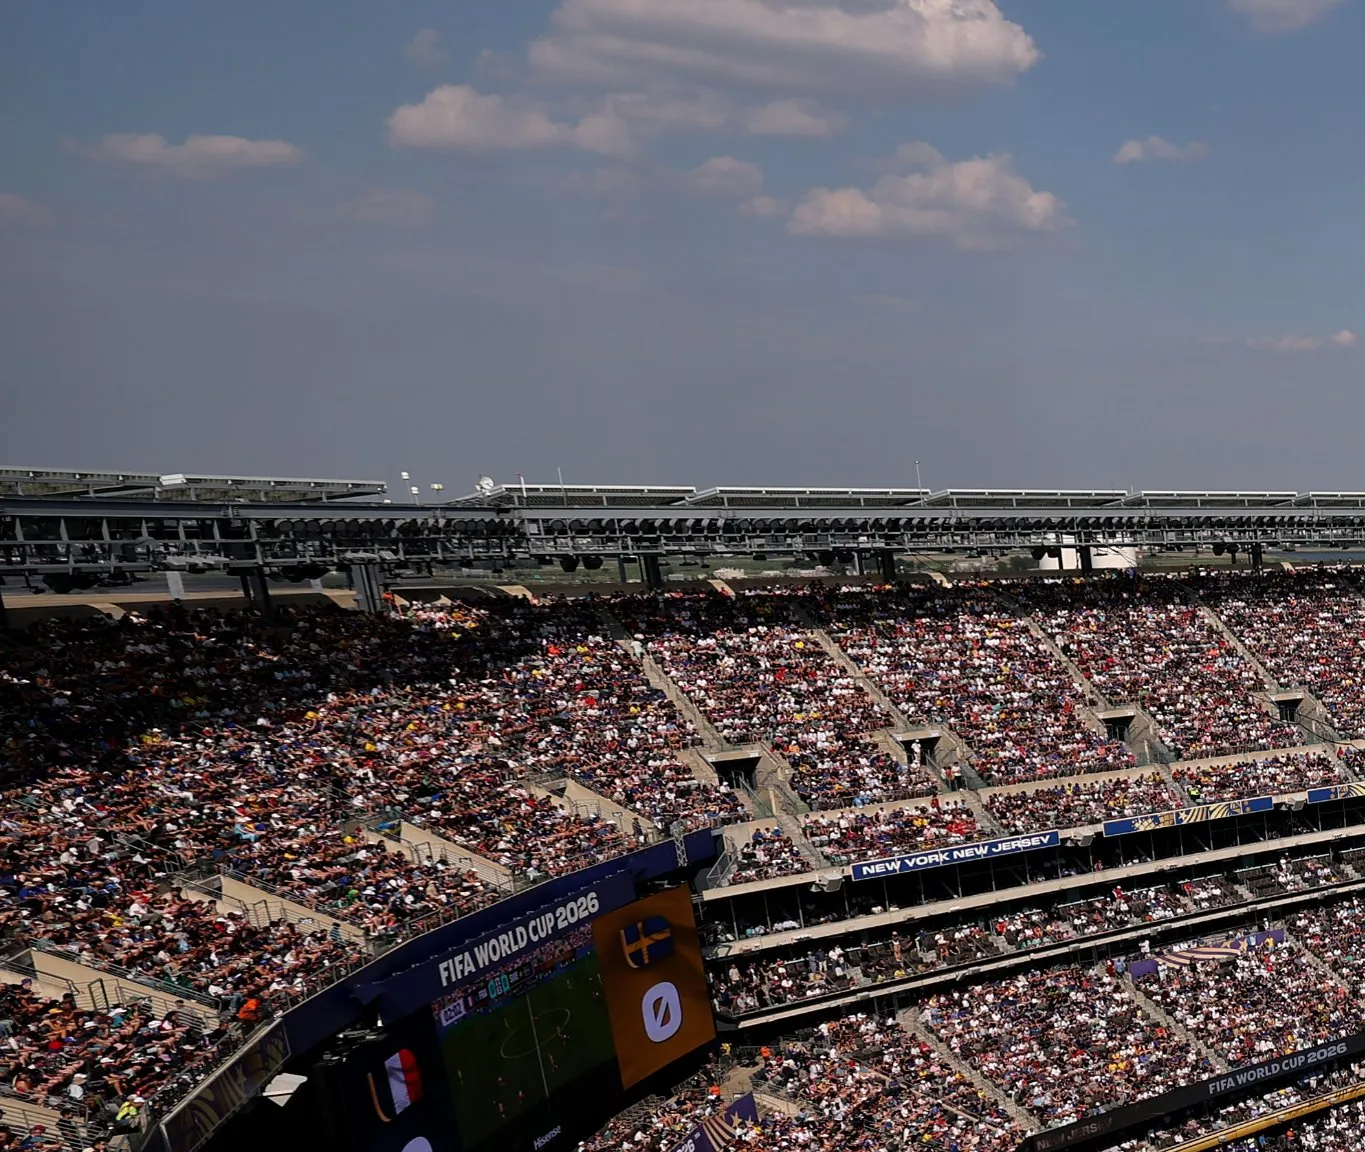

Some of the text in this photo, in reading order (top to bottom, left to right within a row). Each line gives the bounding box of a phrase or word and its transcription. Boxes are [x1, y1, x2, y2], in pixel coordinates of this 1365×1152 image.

[862, 835, 1050, 876] NEW YORK NEW JERSEY
[438, 954, 476, 987] FIFA
[473, 926, 527, 968] WORLD
[528, 912, 555, 942] CUP
[555, 891, 600, 930] 2026
[1208, 1042, 1349, 1095] FIFA WORLD CUP 2026
